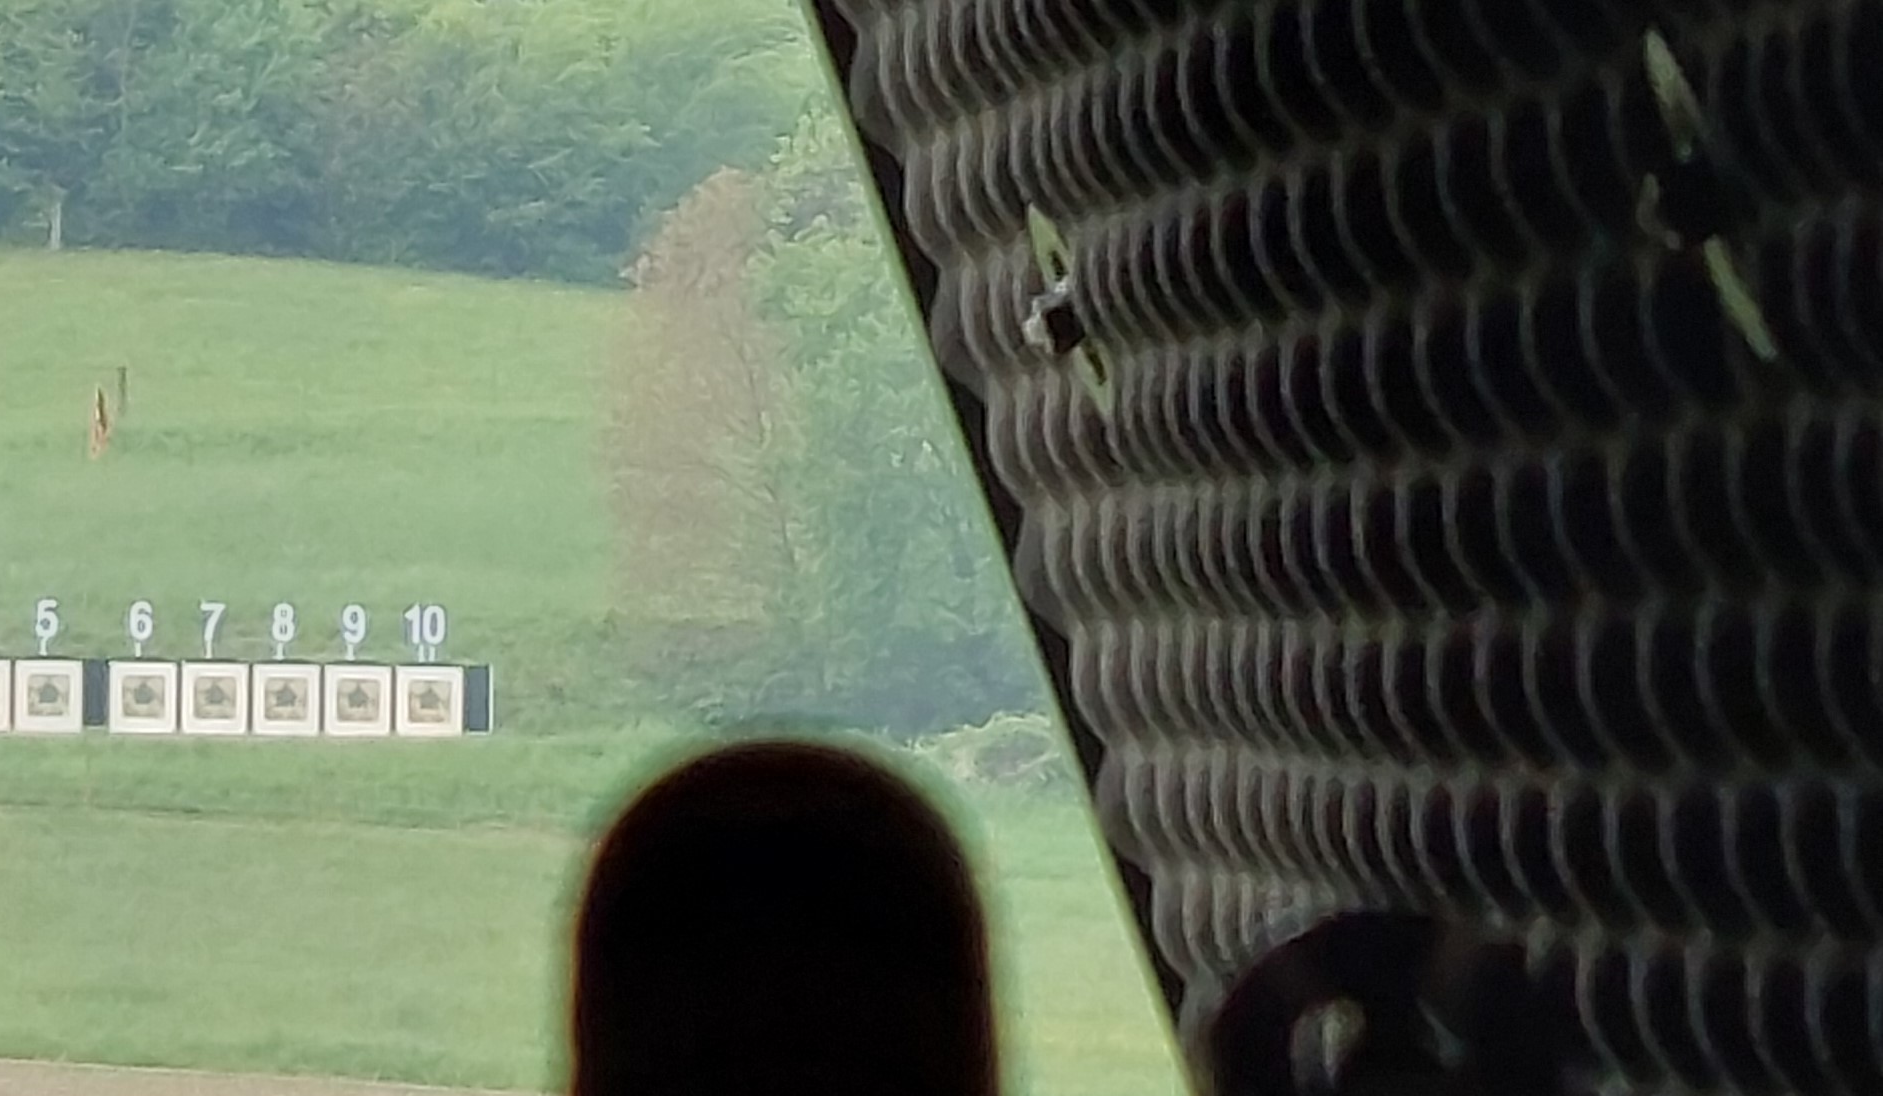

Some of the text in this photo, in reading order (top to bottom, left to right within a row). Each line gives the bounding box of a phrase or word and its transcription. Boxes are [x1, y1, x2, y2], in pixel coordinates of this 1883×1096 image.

[35, 599, 58, 638] 5
[129, 601, 153, 640] 6
[200, 602, 225, 641] 7
[272, 603, 295, 642] 8
[342, 605, 366, 644] 9
[404, 604, 446, 644] 10
